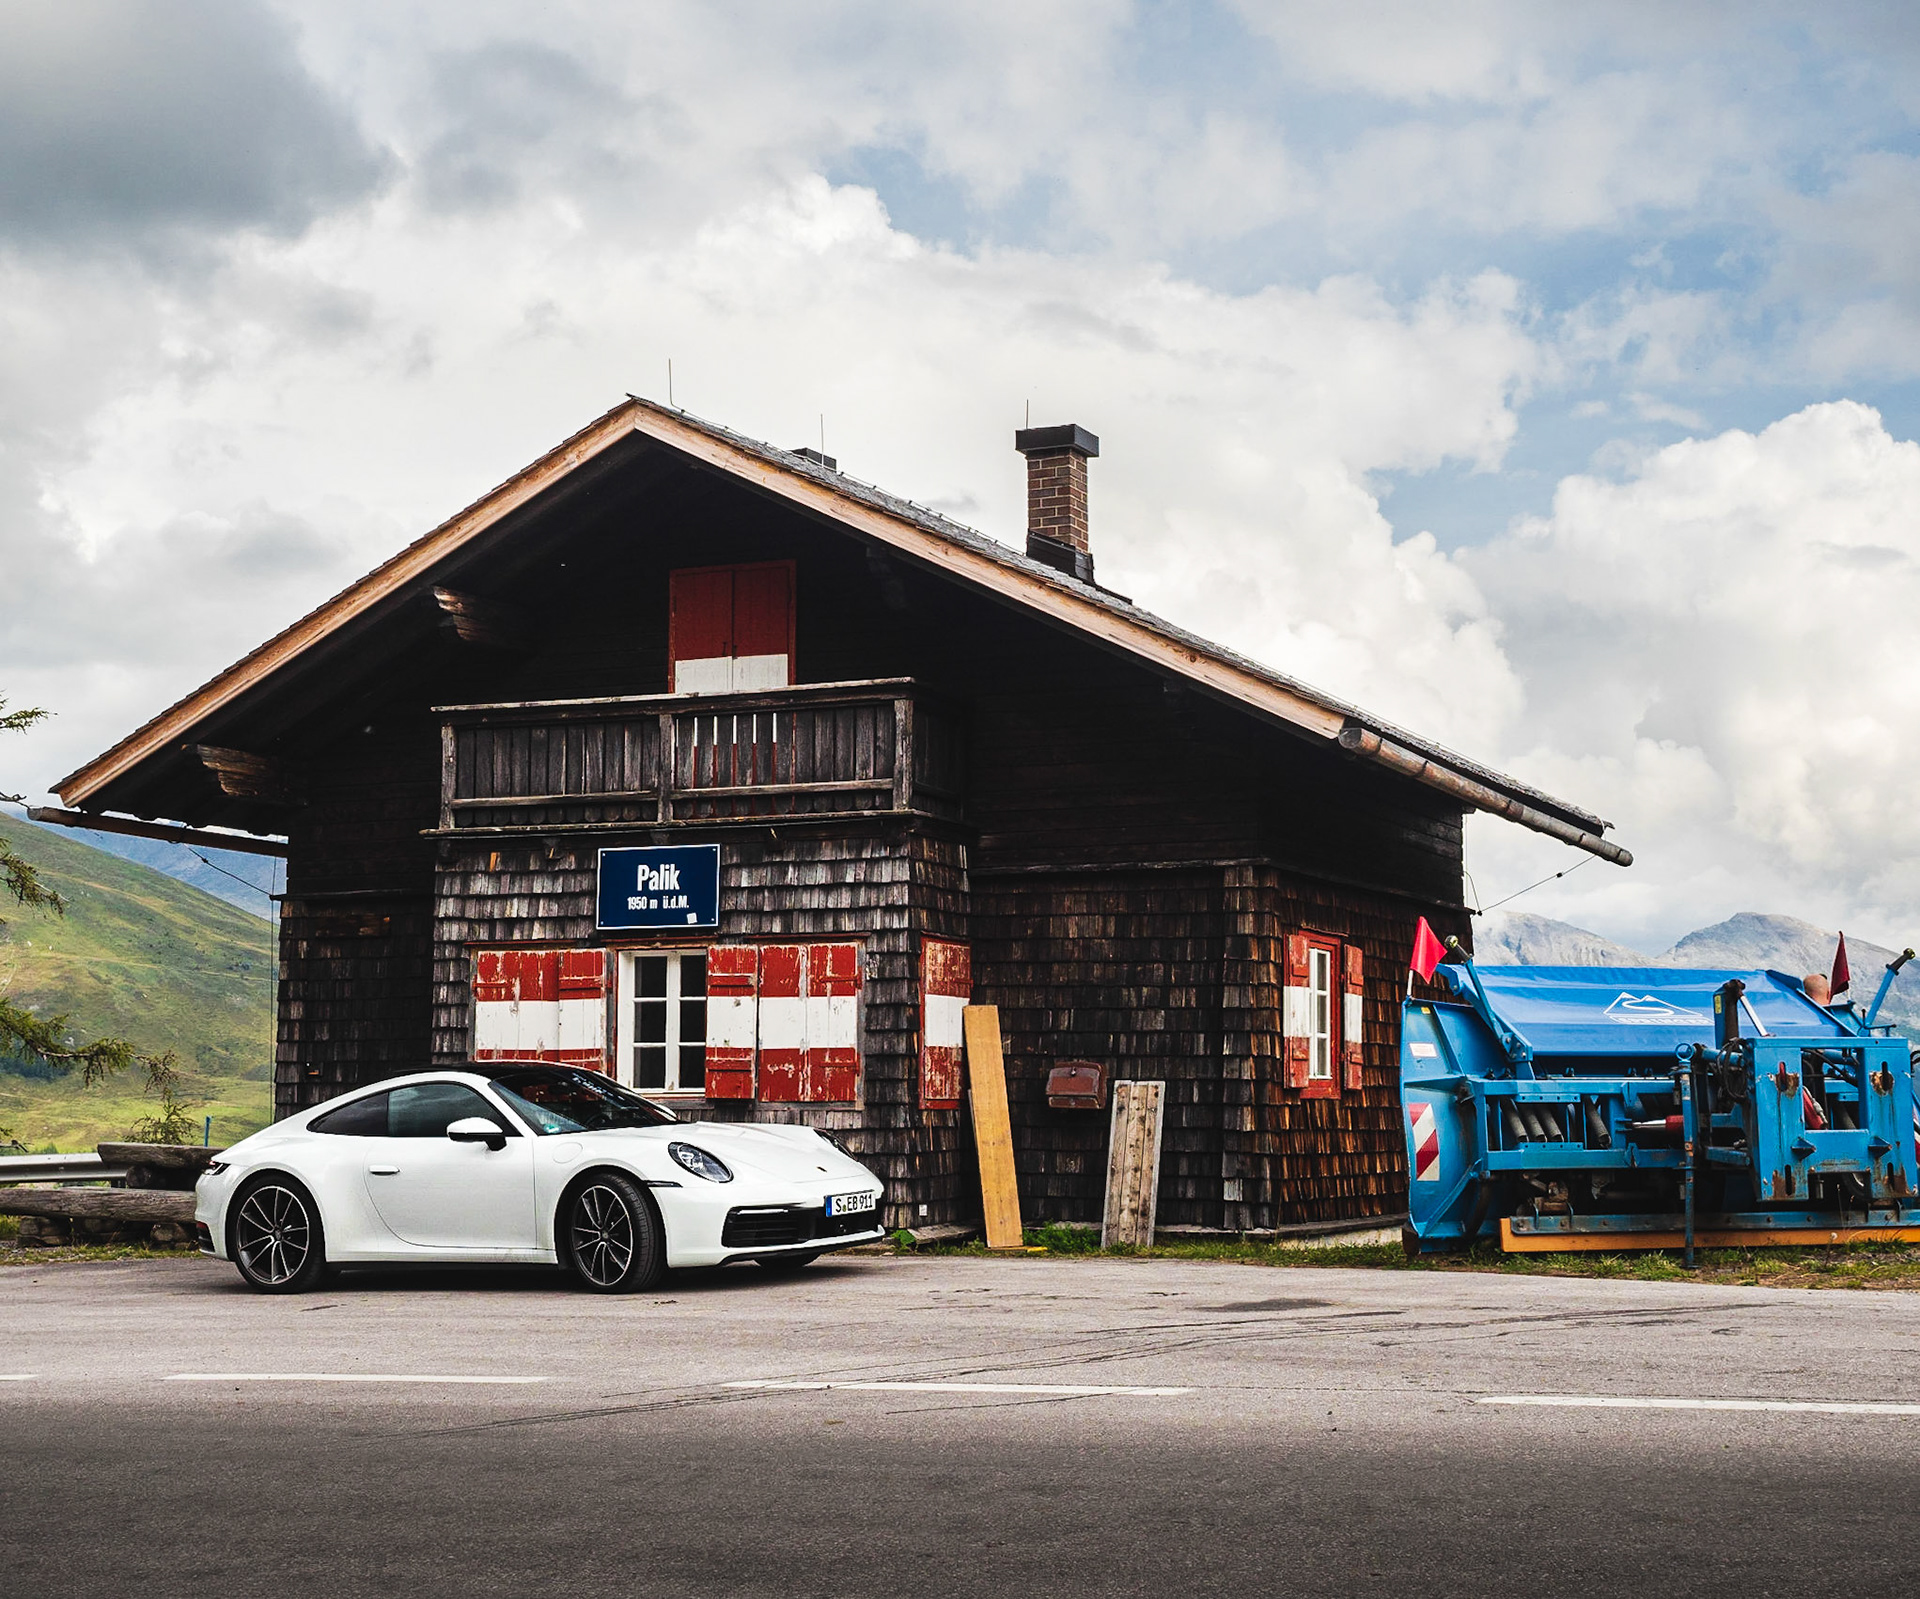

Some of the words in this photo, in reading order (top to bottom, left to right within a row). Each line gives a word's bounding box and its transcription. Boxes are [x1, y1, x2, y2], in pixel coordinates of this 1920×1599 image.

[637, 864, 681, 891] Palik
[627, 896, 647, 910] 1950
[649, 899, 658, 909] m
[662, 895, 690, 909] ü.d.M.
[835, 1198, 842, 1213] S
[859, 1193, 873, 1210] 911
